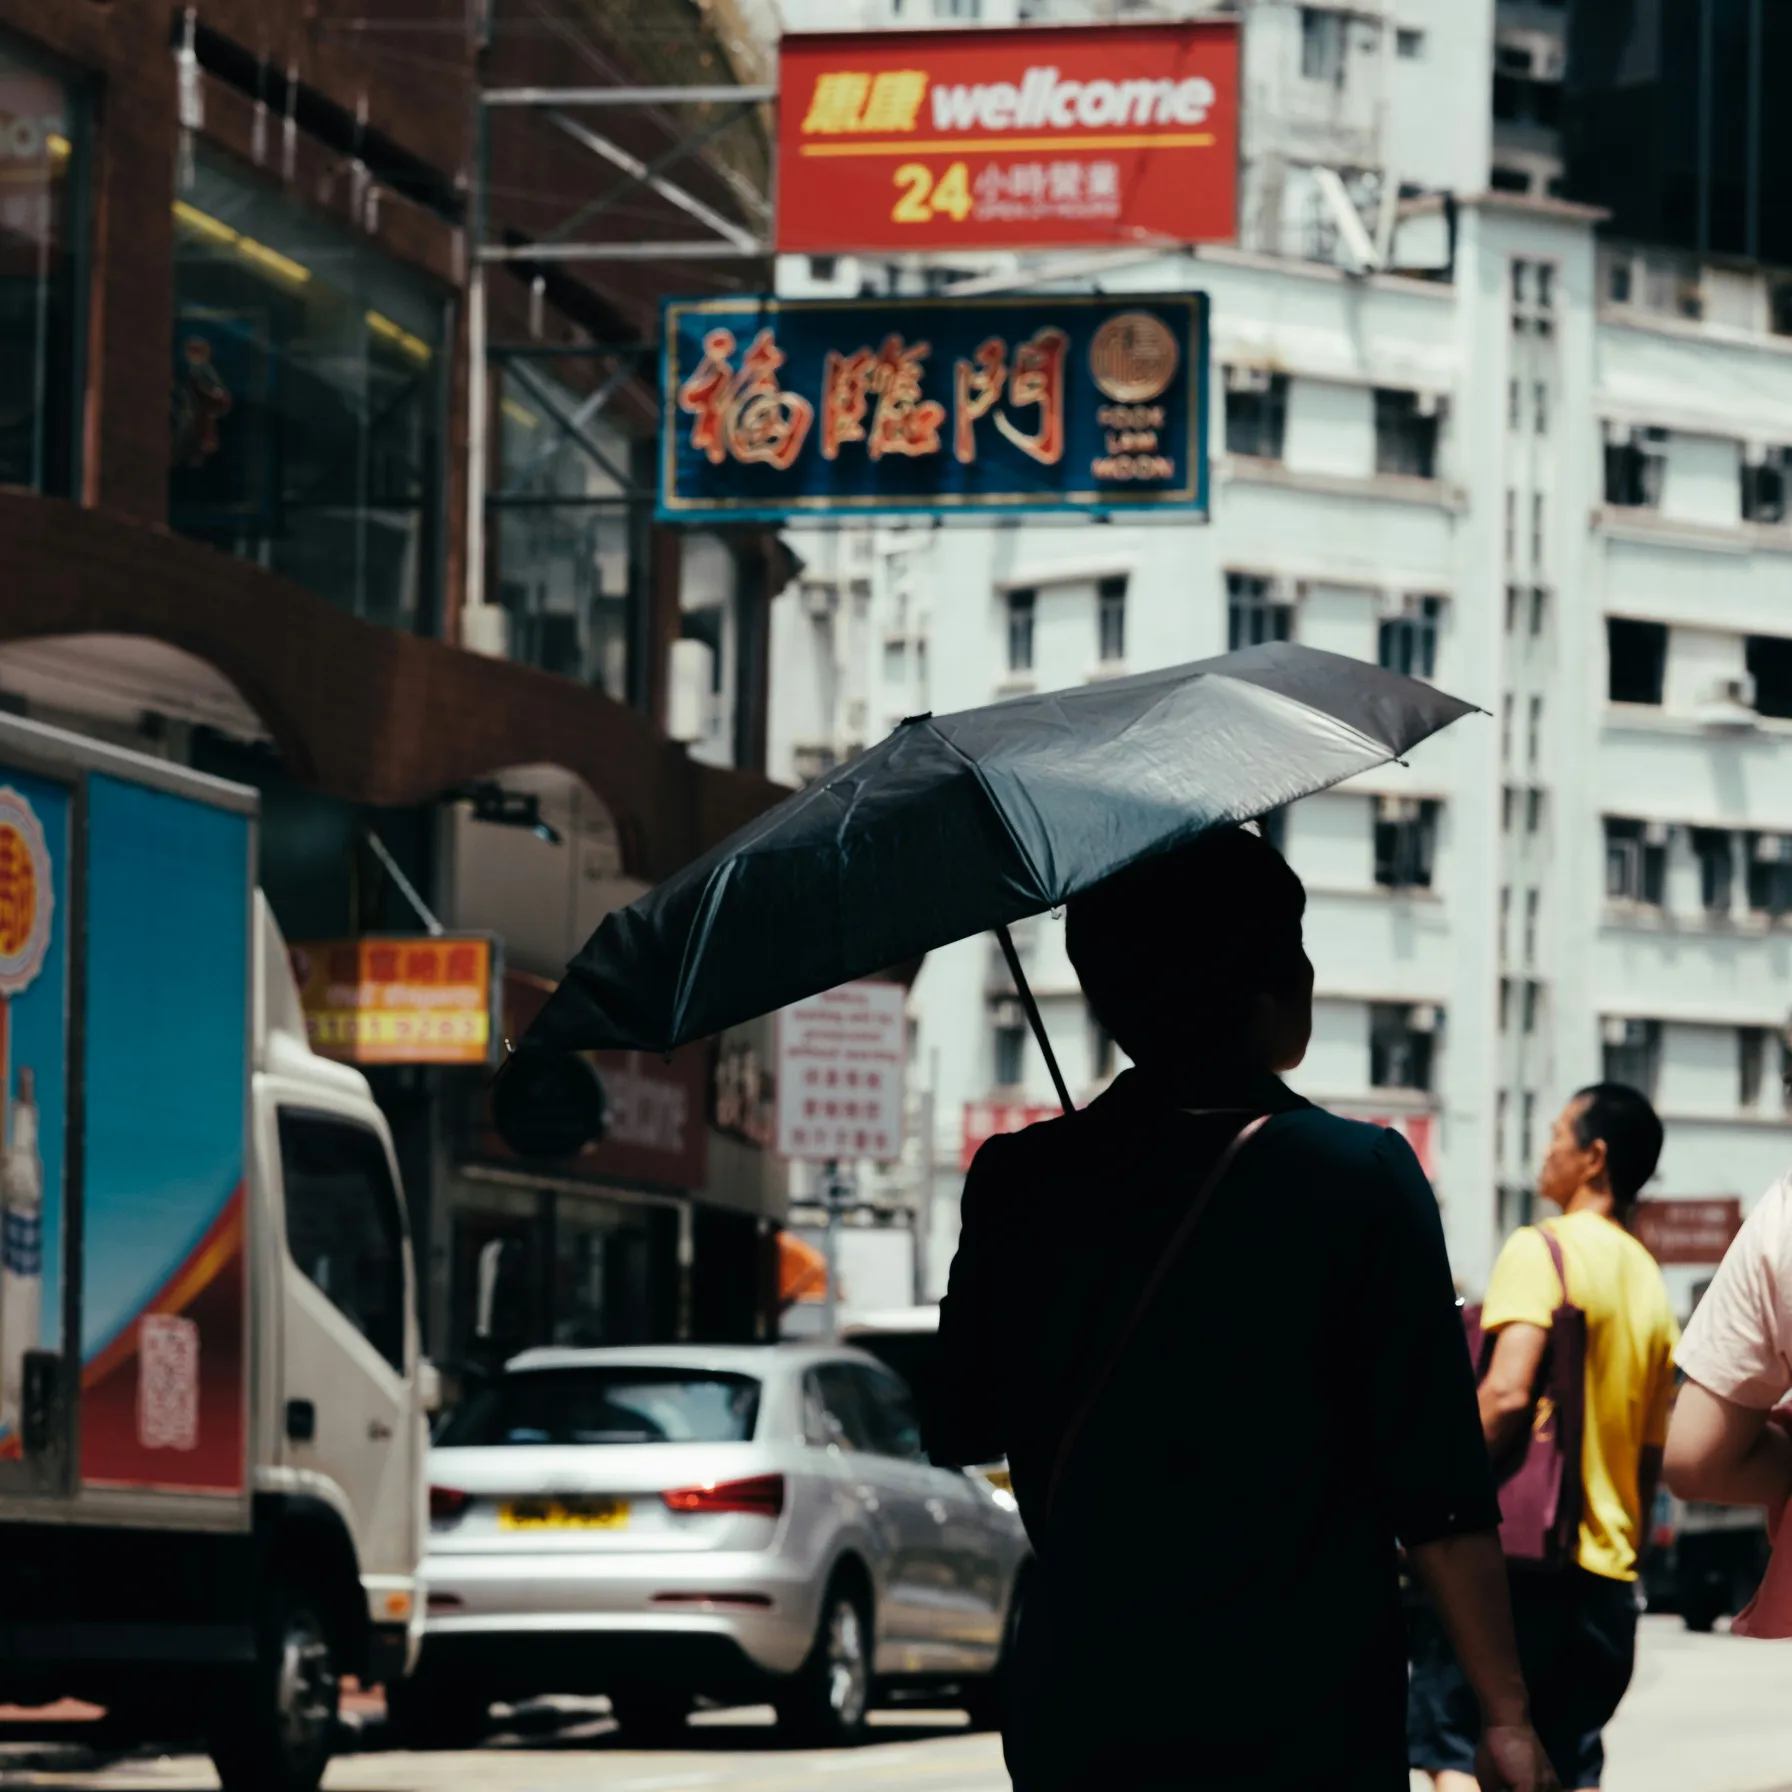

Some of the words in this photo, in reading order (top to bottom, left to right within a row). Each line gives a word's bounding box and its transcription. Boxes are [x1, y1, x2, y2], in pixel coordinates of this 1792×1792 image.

[803, 71, 928, 133] 惠康
[932, 66, 1215, 131] wellcome
[892, 162, 974, 222] 24
[680, 327, 1069, 470] 福臨門
[1091, 455, 1174, 480] MOON
